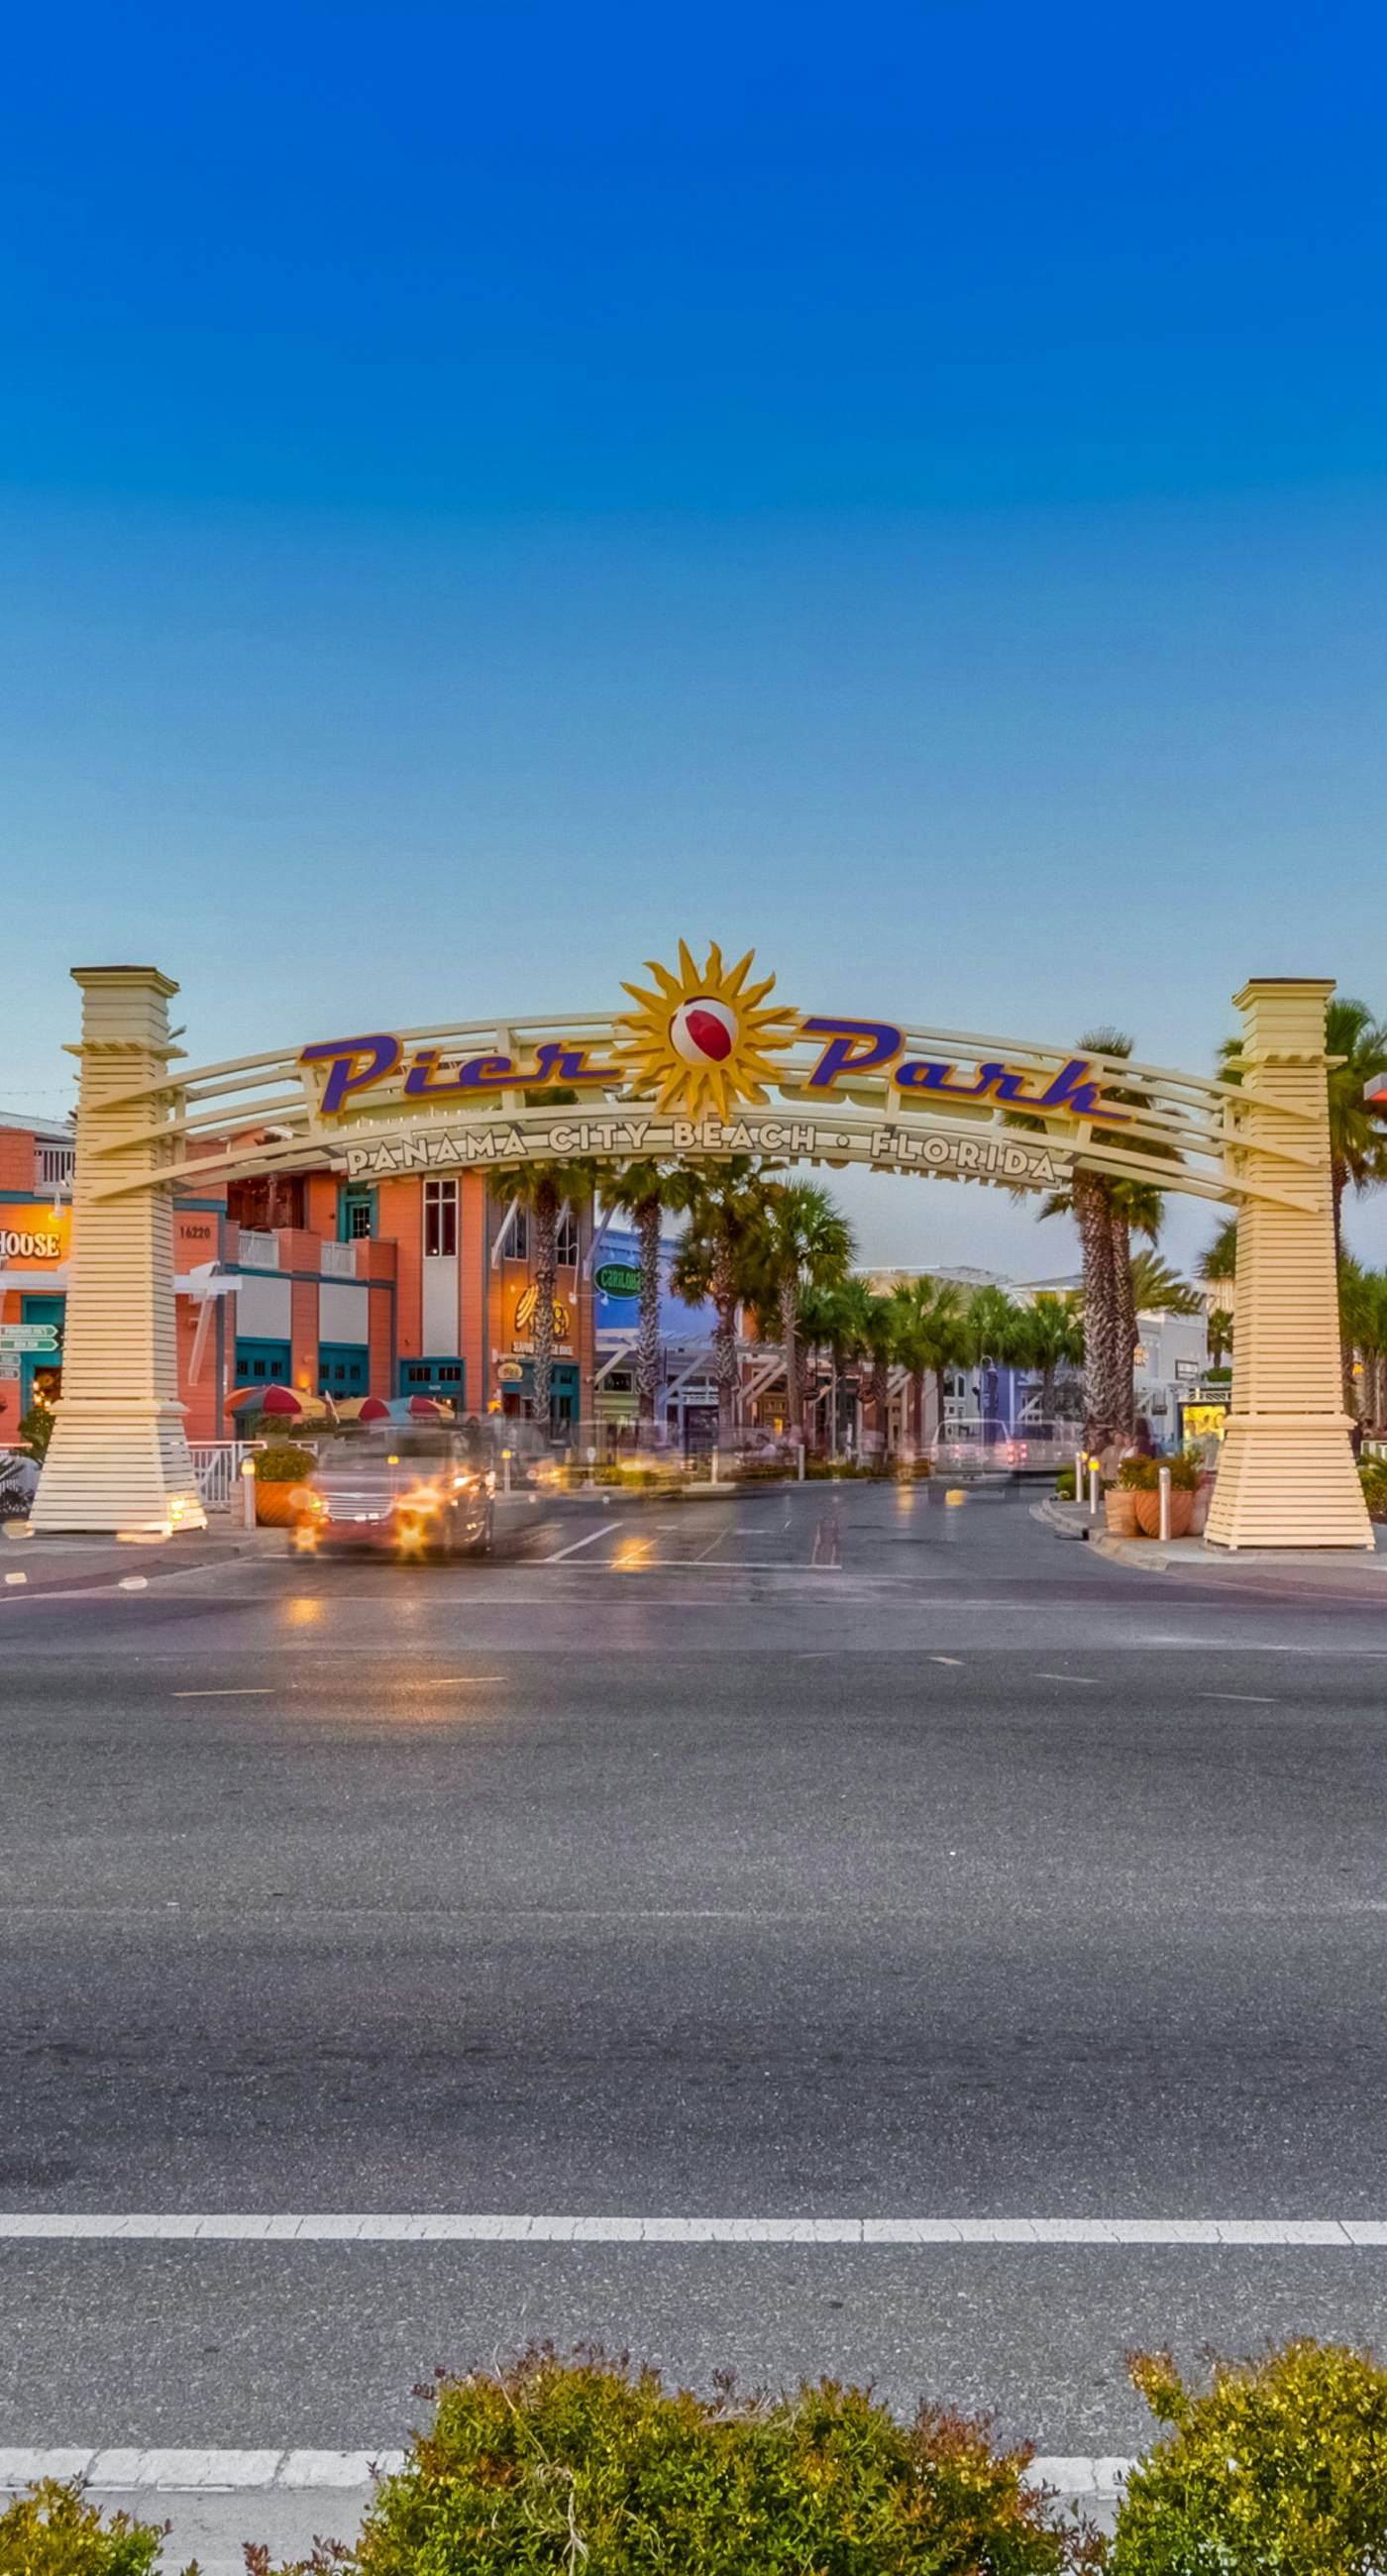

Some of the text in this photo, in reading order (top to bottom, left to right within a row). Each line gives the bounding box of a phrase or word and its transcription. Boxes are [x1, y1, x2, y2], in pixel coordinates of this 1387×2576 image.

[299, 1016, 1134, 1124] Pier Park
[347, 1119, 1056, 1183] PANAMA CITY BEACH FLORIDA
[180, 1227, 211, 1238] 16220
